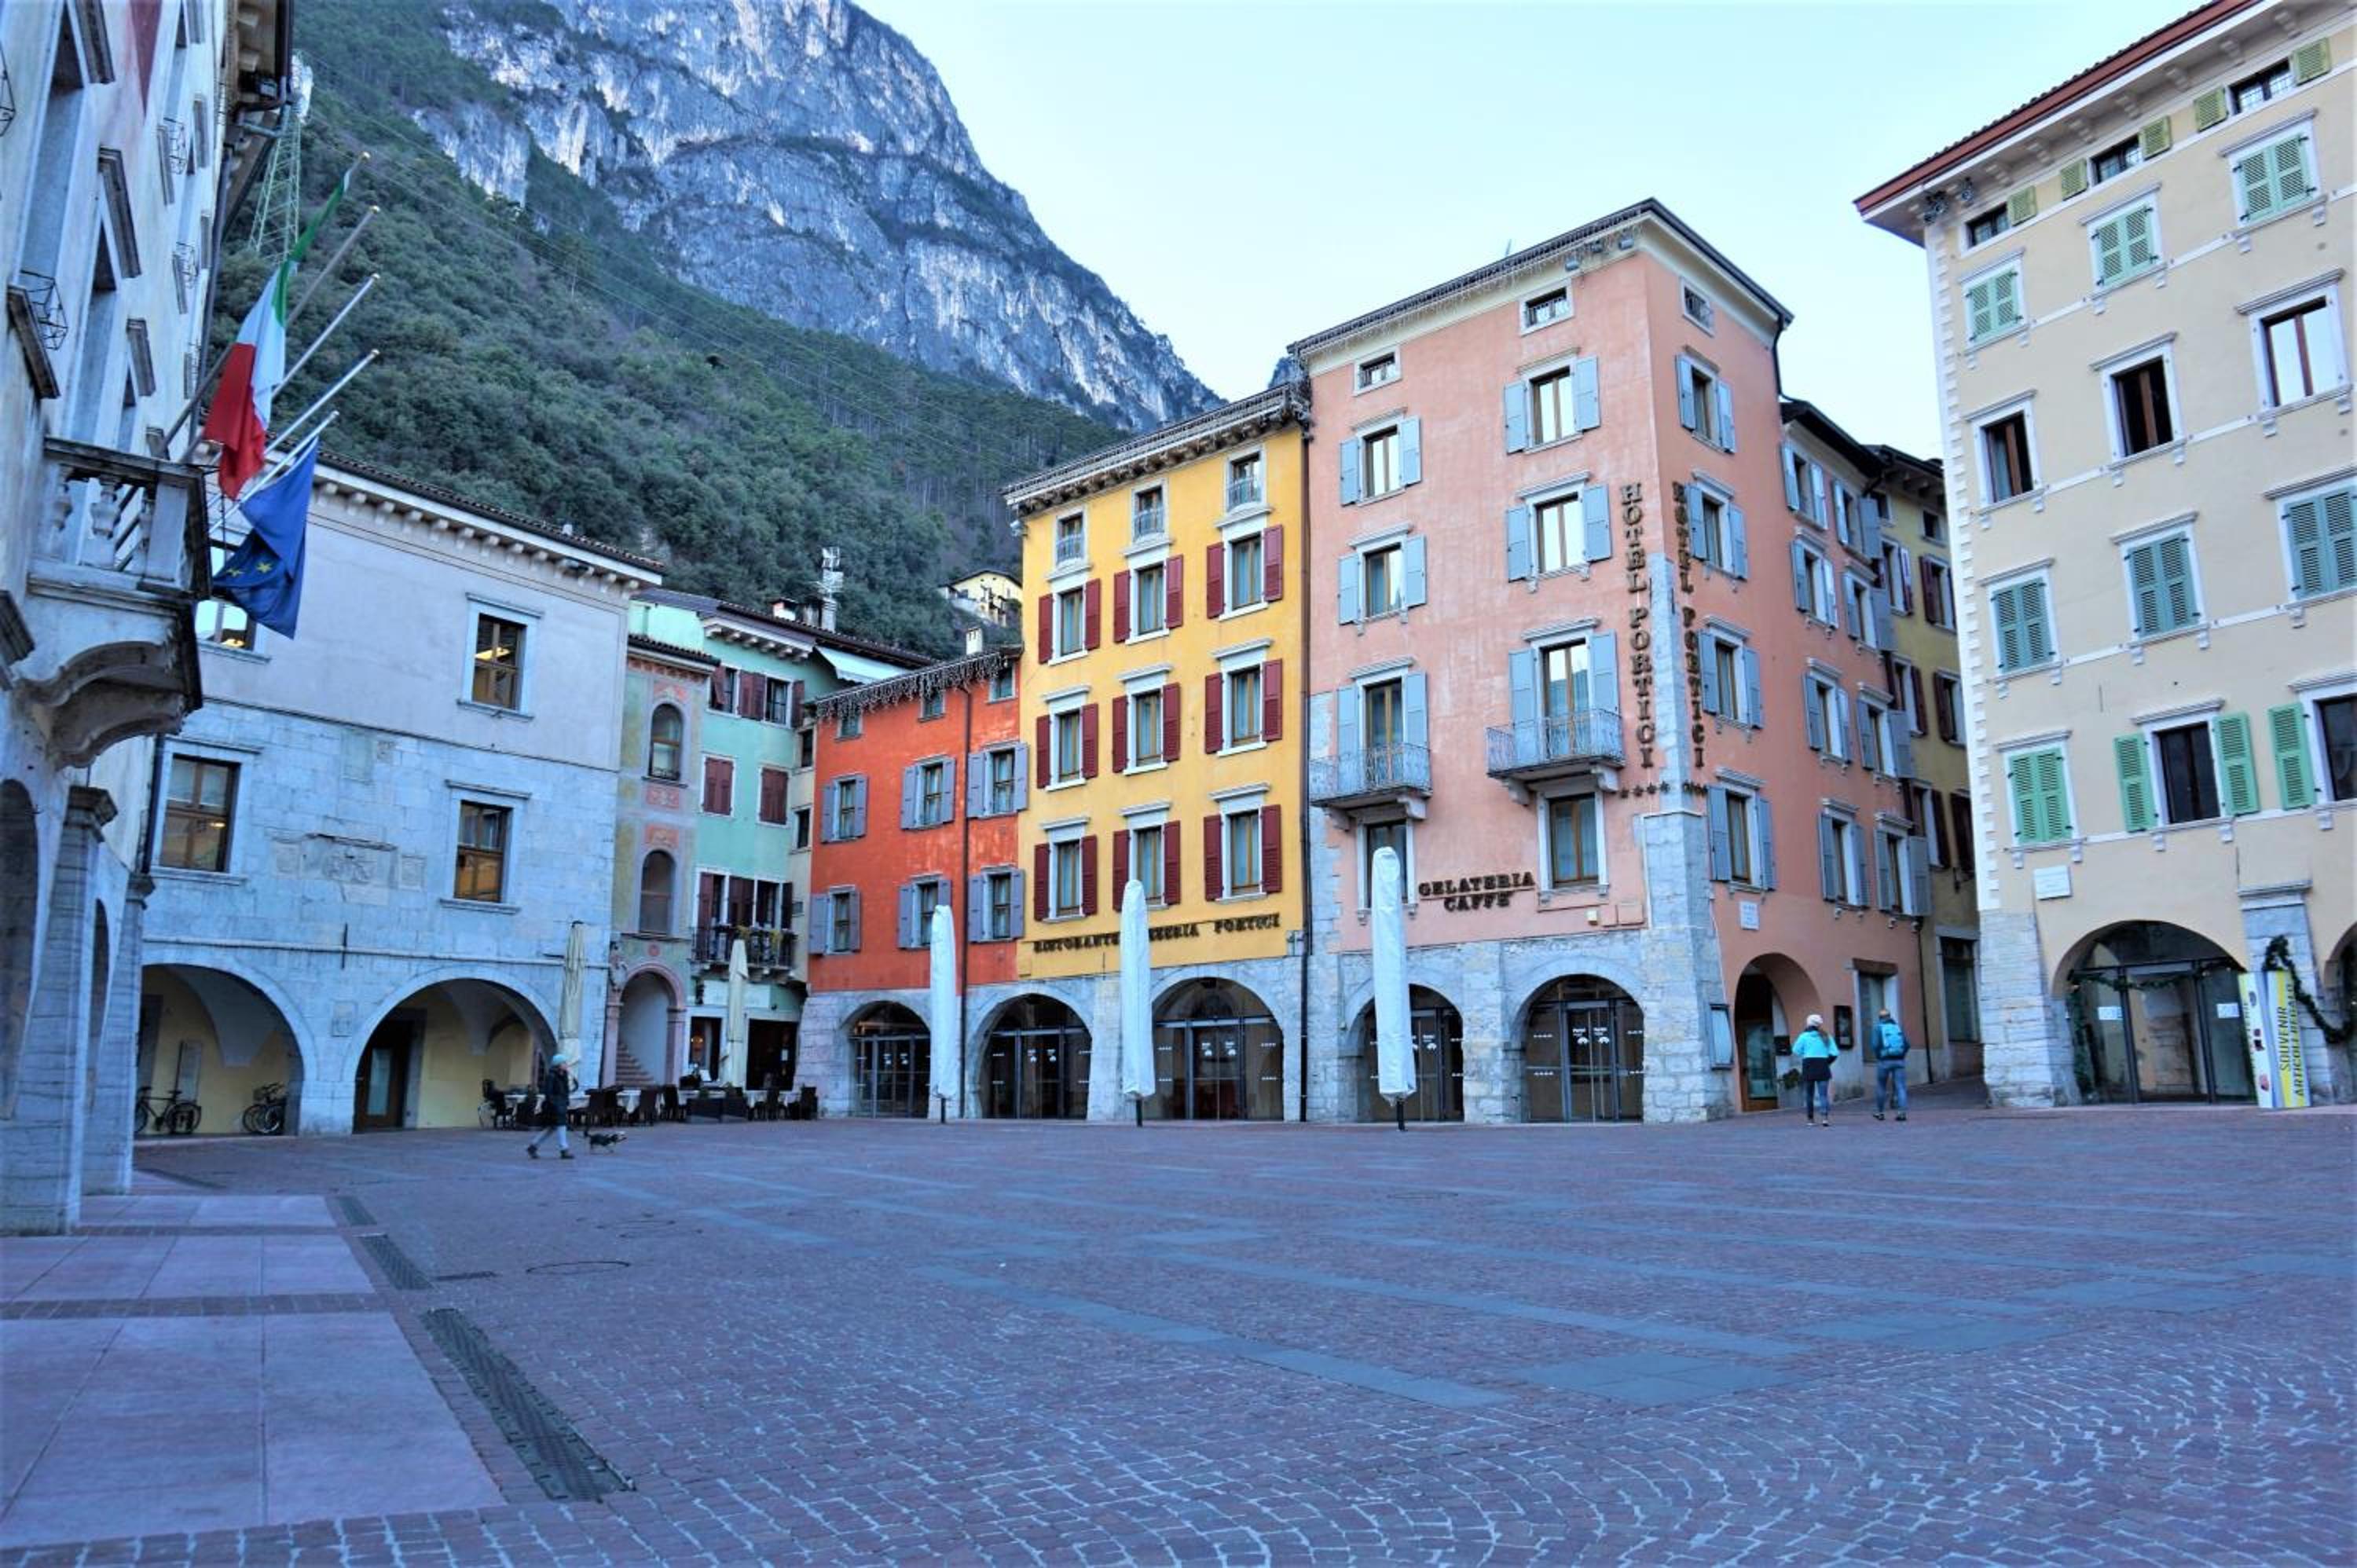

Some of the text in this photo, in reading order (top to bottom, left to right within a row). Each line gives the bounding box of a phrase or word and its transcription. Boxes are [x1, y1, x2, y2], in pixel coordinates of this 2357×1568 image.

[1620, 482, 1655, 768] HOTEL PORTICI
[1672, 482, 1705, 768] HOTEL PORTICI
[1418, 871, 1535, 896] GELATERIA
[1214, 913, 1281, 934] PORTICI
[2278, 1006, 2291, 1072] SOUVENIR
[2289, 1037, 2304, 1097] ARTICOLI
